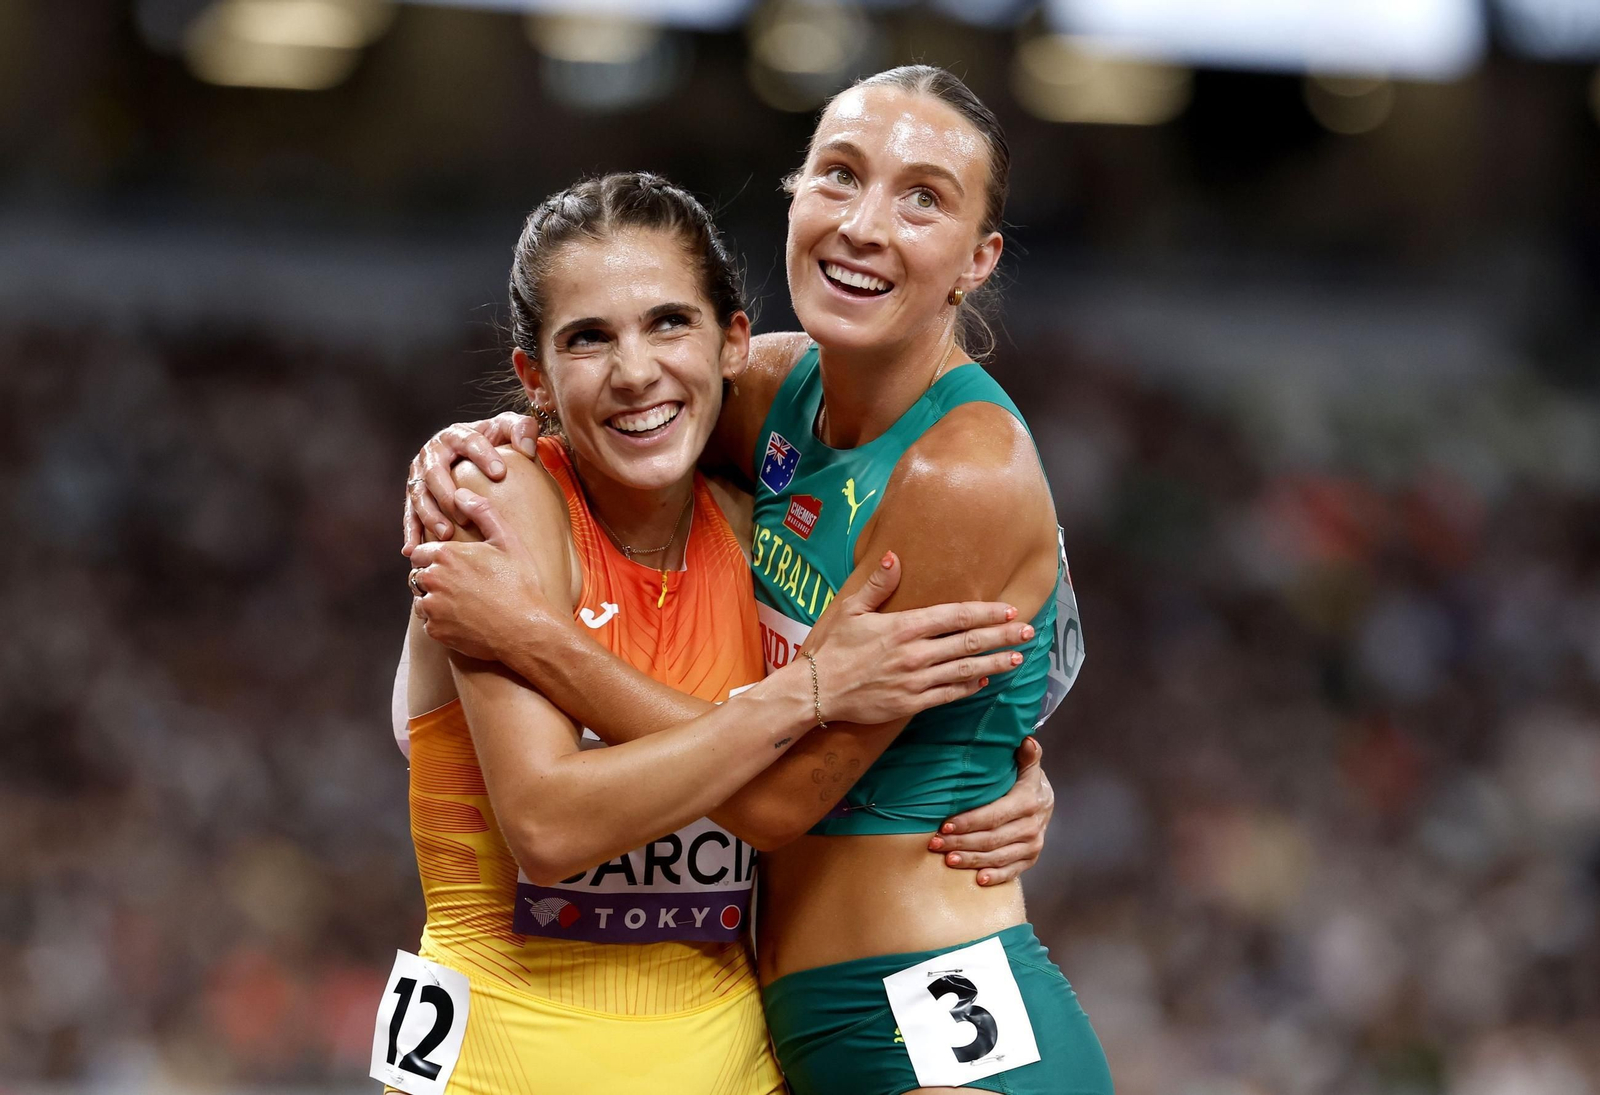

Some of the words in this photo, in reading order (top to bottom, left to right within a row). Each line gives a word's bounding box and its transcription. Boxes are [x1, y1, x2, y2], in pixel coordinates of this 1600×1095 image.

[790, 501, 818, 527] CHEMIST
[386, 976, 455, 1081] 12
[927, 974, 998, 1063] 3
